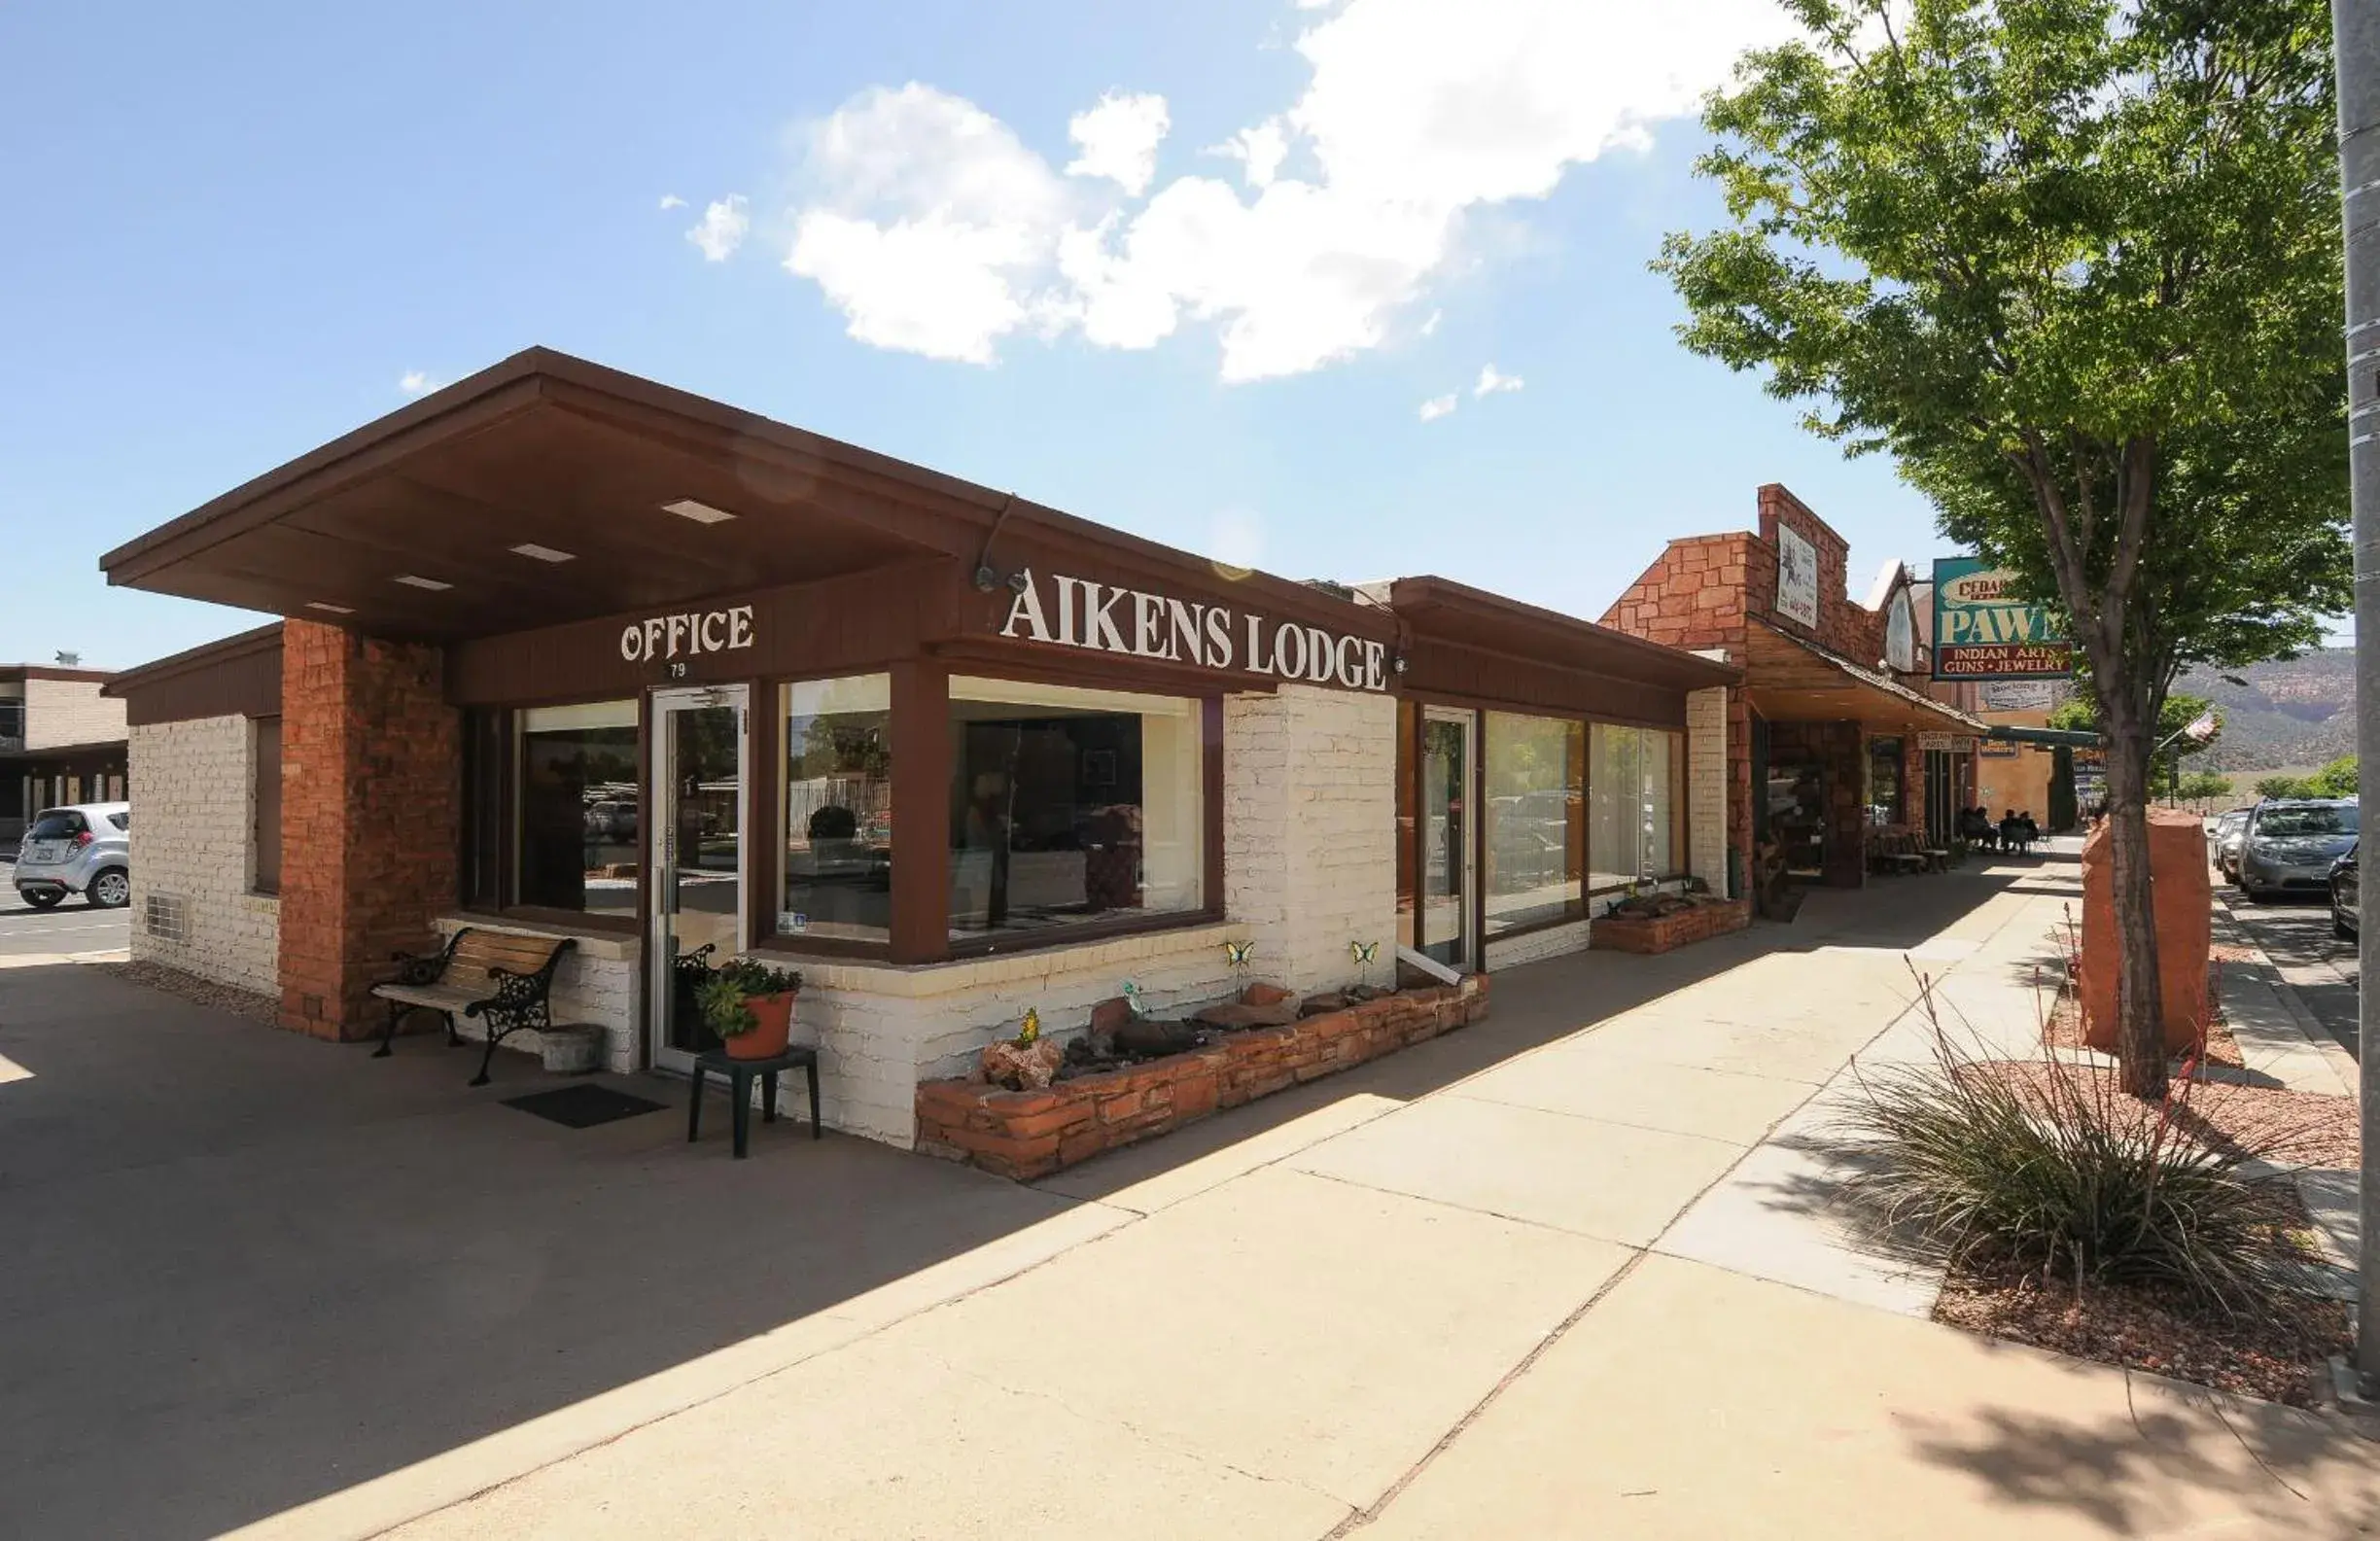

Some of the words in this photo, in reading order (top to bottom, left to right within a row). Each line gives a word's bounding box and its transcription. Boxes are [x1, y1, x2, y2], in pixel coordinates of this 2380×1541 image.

[621, 605, 753, 661] OFFICE
[999, 568, 1233, 669] AIKENS
[1244, 613, 1386, 691] LODGE
[1954, 648, 2008, 659] INDIAN
[671, 663, 685, 677] 79
[1944, 661, 1984, 673] GUNS
[1995, 660, 2064, 672] JEWELRY
